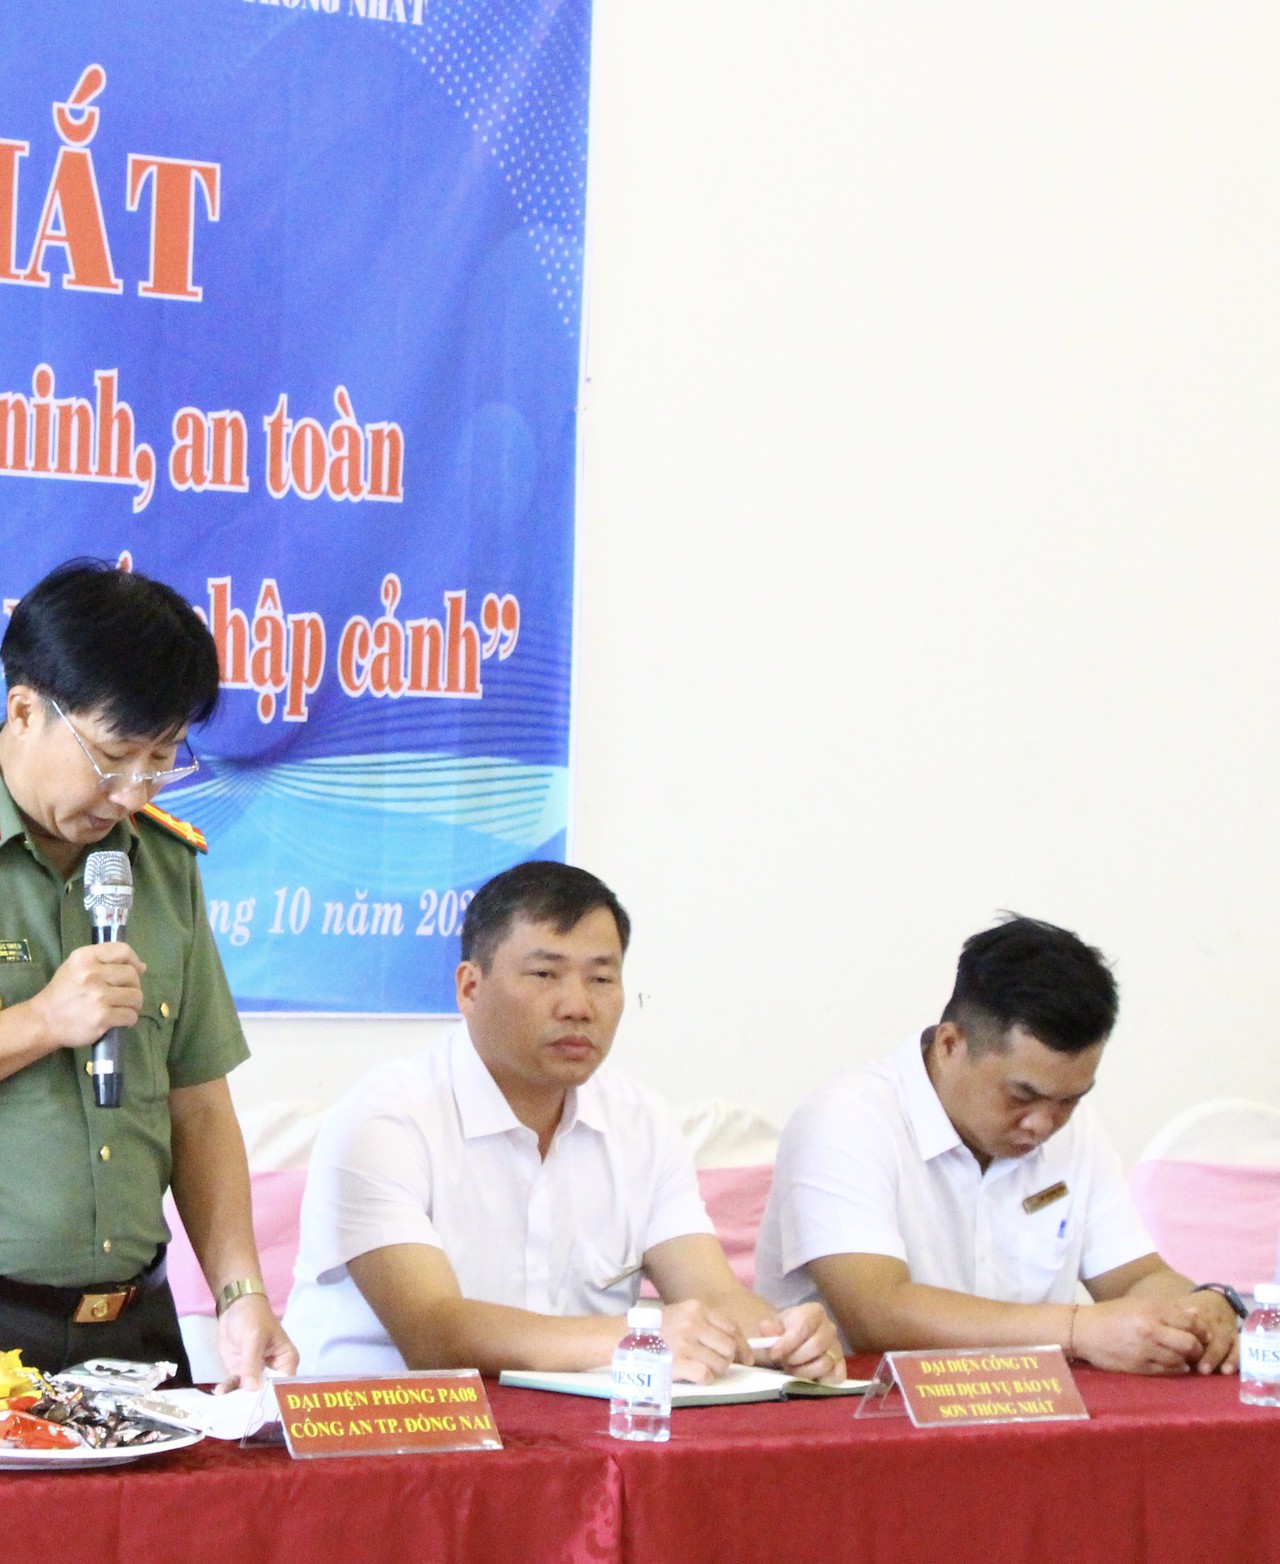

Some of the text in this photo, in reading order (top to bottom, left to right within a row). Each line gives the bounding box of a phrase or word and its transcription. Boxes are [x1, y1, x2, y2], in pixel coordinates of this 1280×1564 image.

[169, 406, 249, 493] an
[264, 385, 405, 503] toàn
[197, 576, 326, 724] hập
[338, 573, 520, 700] cảnh”
[268, 886, 311, 935] 10
[321, 889, 404, 936] năm
[416, 889, 476, 937] 202
[1021, 1356, 1038, 1370] TY
[1249, 1346, 1280, 1362] MES
[287, 1385, 477, 1412] ĐẠI DIỆN PHÒNG PA08
[916, 1383, 956, 1398] TNHH
[290, 1413, 492, 1438] CÔNG AN TP. ĐỒNG NAI
